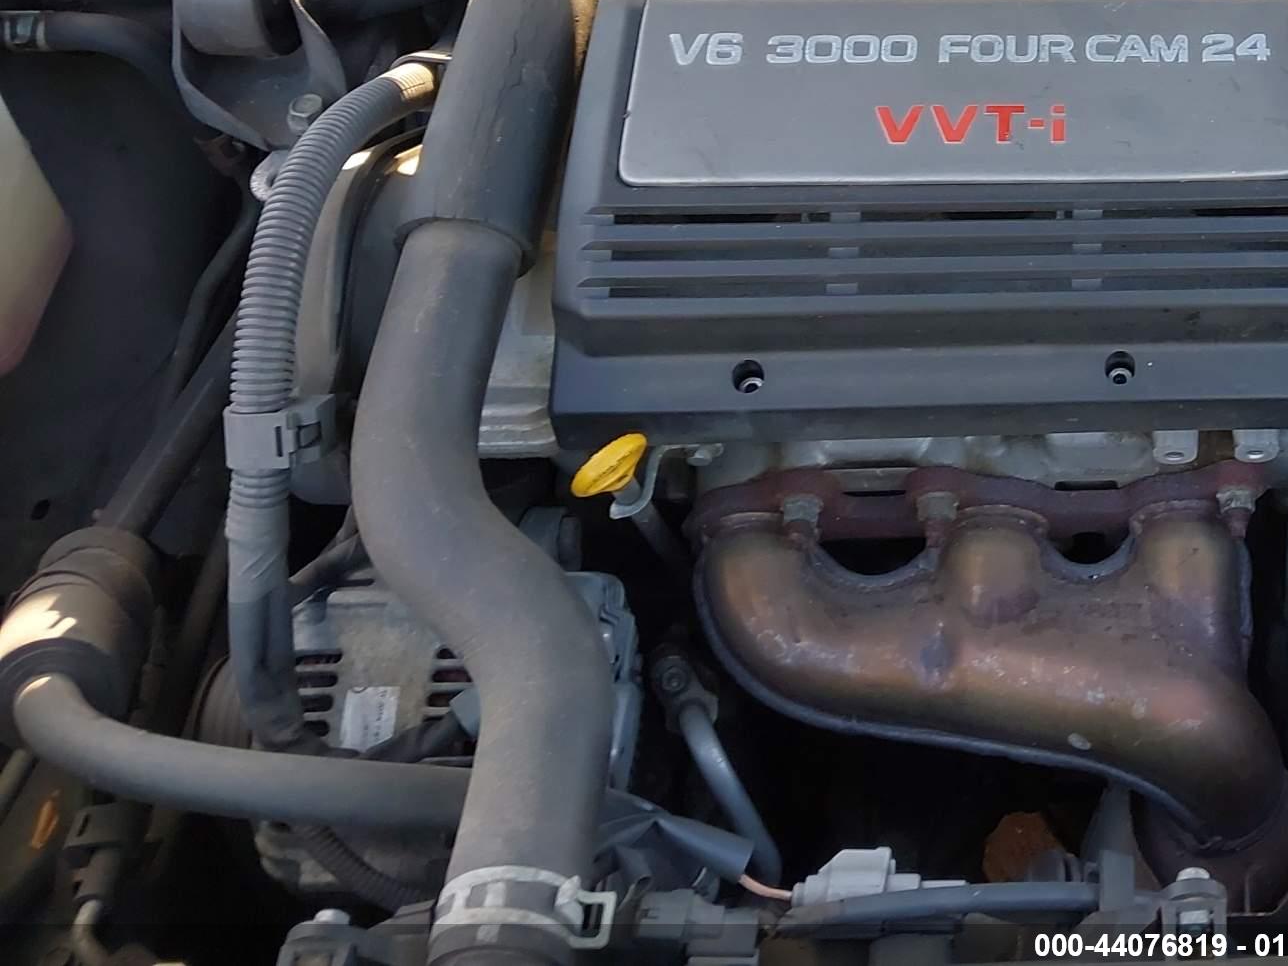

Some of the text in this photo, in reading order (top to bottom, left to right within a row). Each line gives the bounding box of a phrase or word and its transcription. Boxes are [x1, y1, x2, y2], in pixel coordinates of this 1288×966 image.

[670, 32, 1270, 66] V6 3000 FOUR CAM 24
[875, 104, 1067, 145] VVT-i
